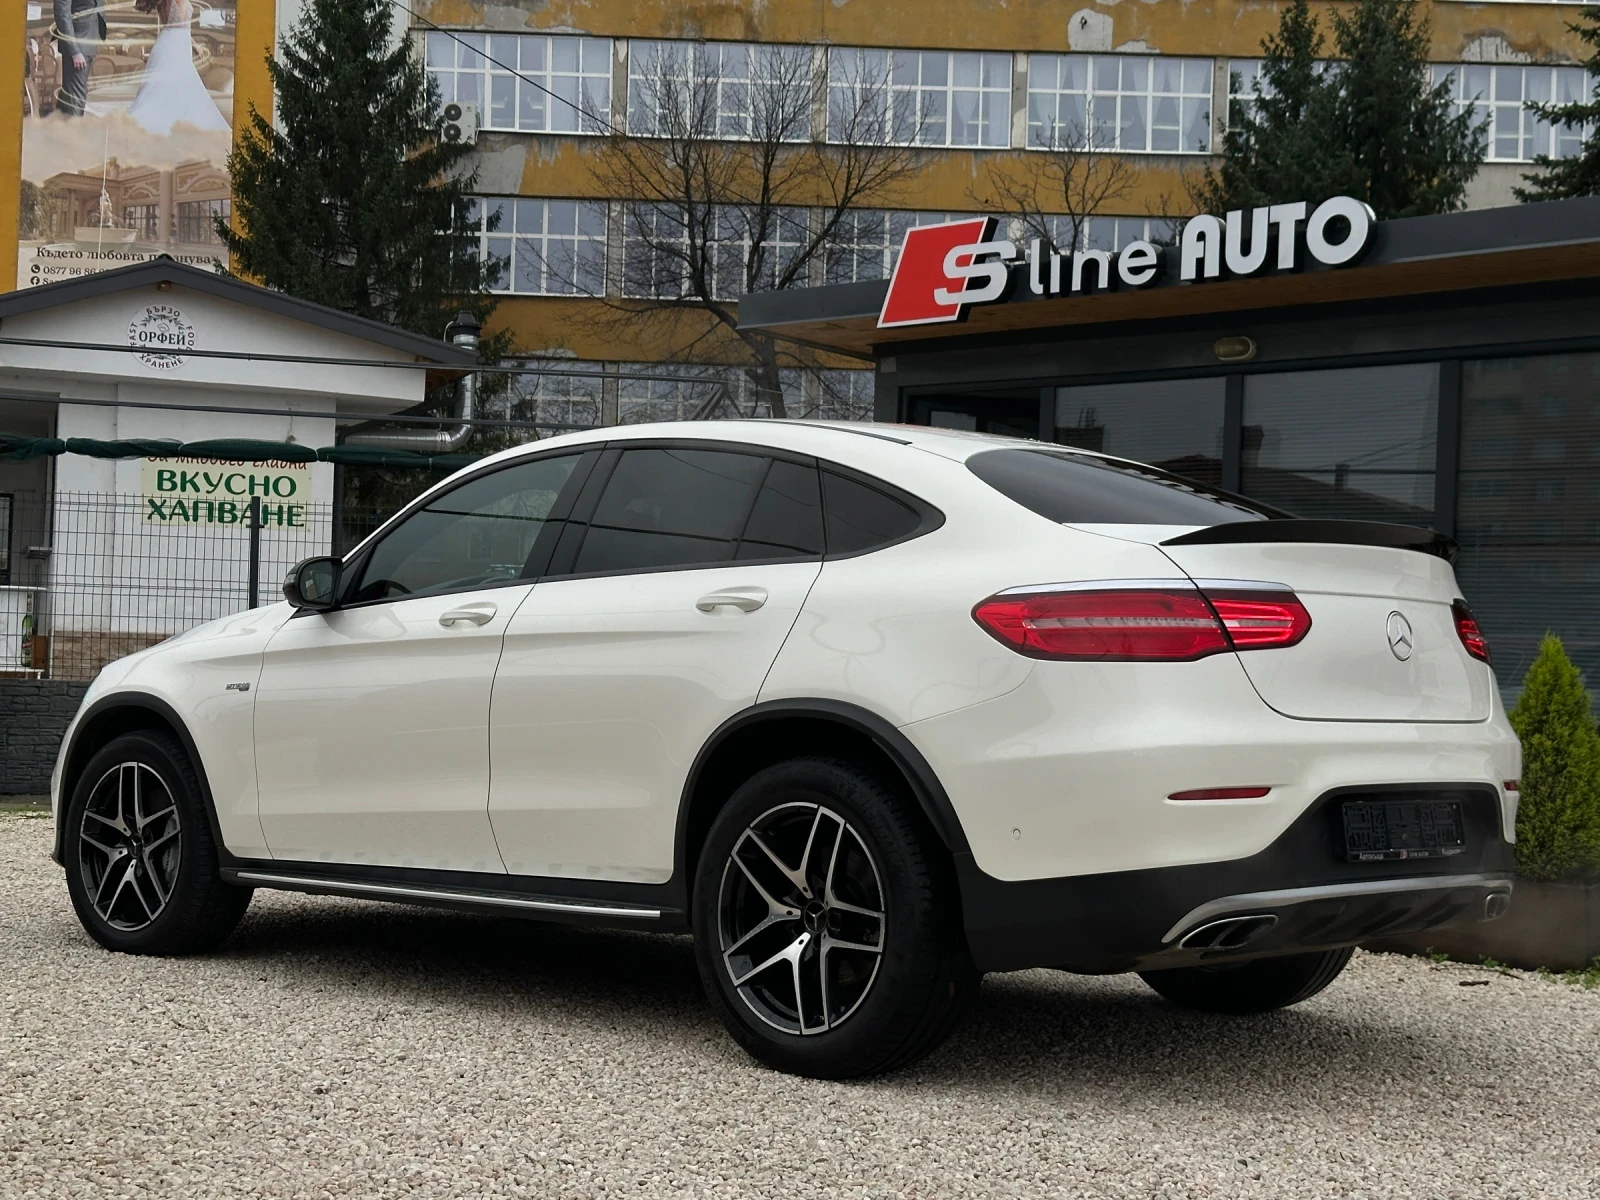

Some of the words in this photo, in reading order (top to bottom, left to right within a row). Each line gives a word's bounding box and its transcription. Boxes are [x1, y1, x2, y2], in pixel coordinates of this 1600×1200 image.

[1029, 238, 1158, 295] line
[1180, 195, 1370, 281] AUTO
[36, 247, 83, 260] Където
[87, 249, 144, 261] любовта
[148, 253, 211, 265] пзнува
[43, 266, 67, 275] 0877
[69, 267, 82, 275] 96
[146, 305, 180, 317] БЪРЗО
[138, 330, 186, 345] ОРФЕЙ
[139, 353, 184, 369] ХРАНЕНЕ
[156, 469, 297, 498] ВКУСНО
